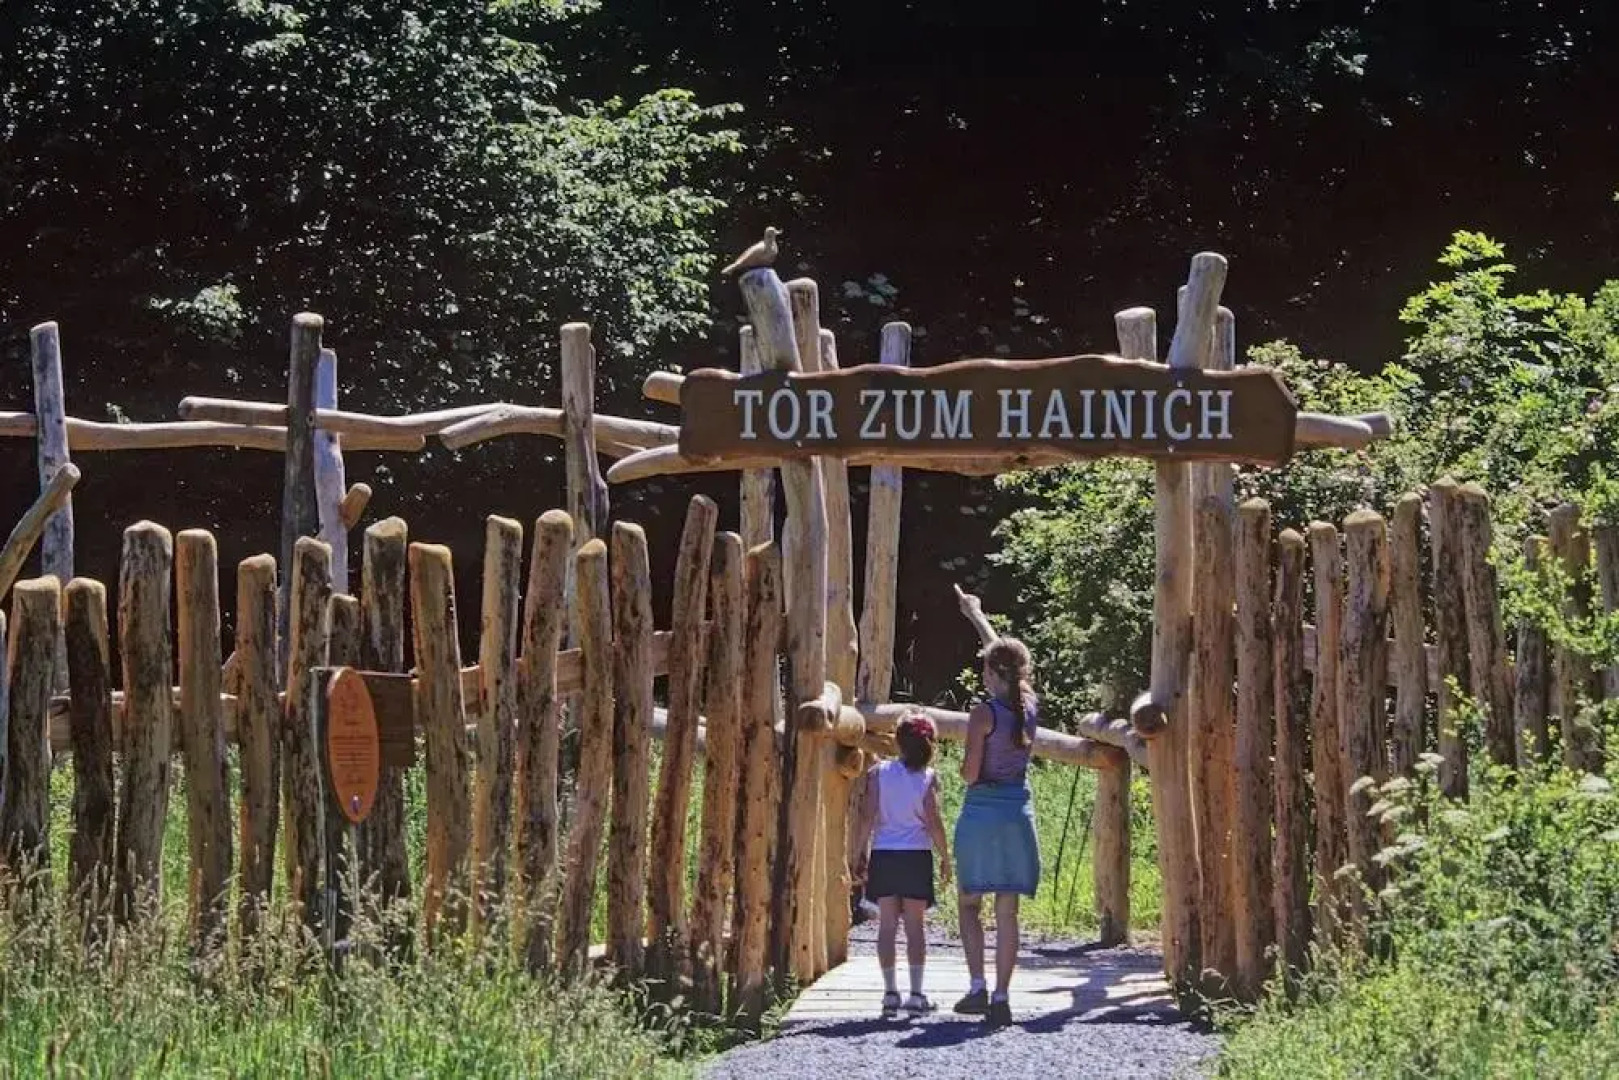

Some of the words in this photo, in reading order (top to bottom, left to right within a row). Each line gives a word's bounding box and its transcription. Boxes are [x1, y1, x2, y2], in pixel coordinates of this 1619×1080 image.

[733, 388, 838, 441] TOR
[859, 388, 973, 440] ZUM
[997, 388, 1234, 440] HAINICH
